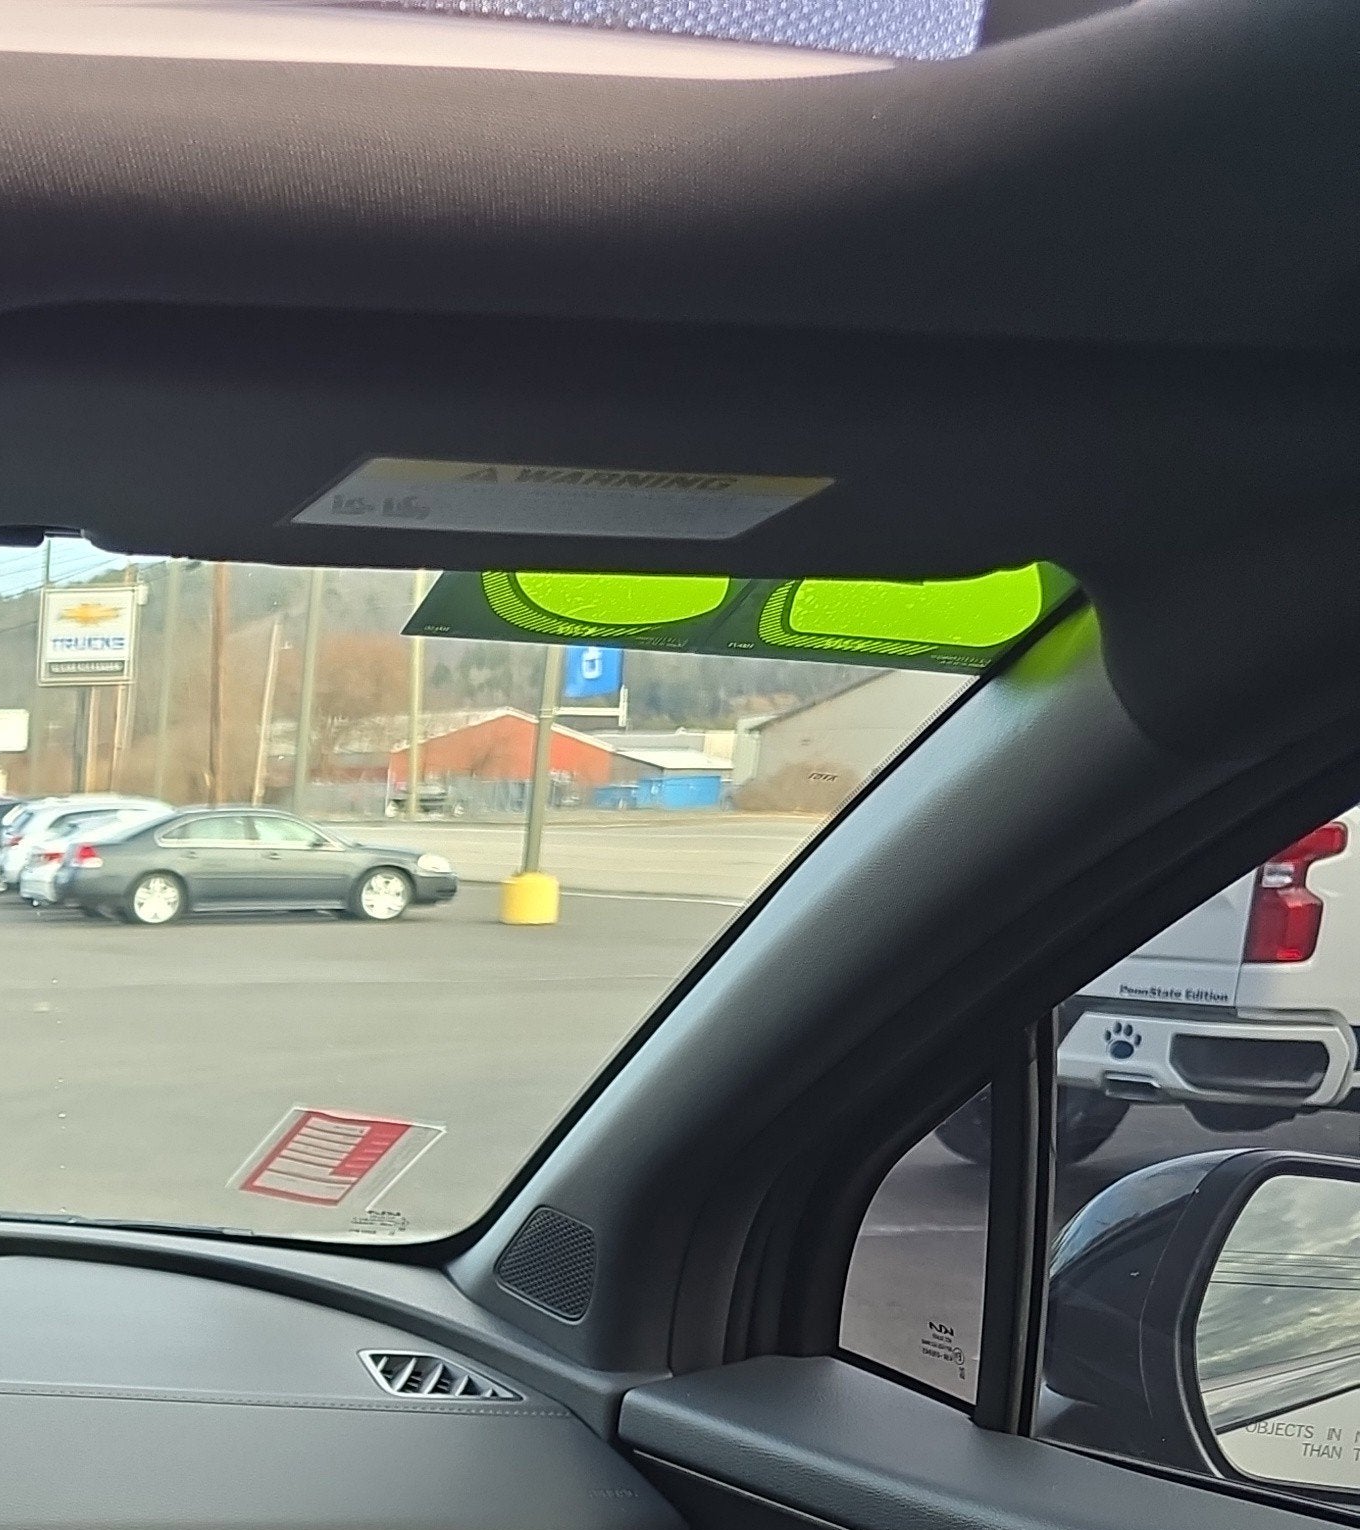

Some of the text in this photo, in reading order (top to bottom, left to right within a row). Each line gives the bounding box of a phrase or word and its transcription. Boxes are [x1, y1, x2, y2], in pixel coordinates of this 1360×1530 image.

[516, 468, 737, 491] WARNING
[1185, 988, 1229, 1001] Edition
[1245, 1420, 1315, 1439] OBJECTS
[1327, 1427, 1342, 1441] IN
[1302, 1442, 1343, 1460] THAN
